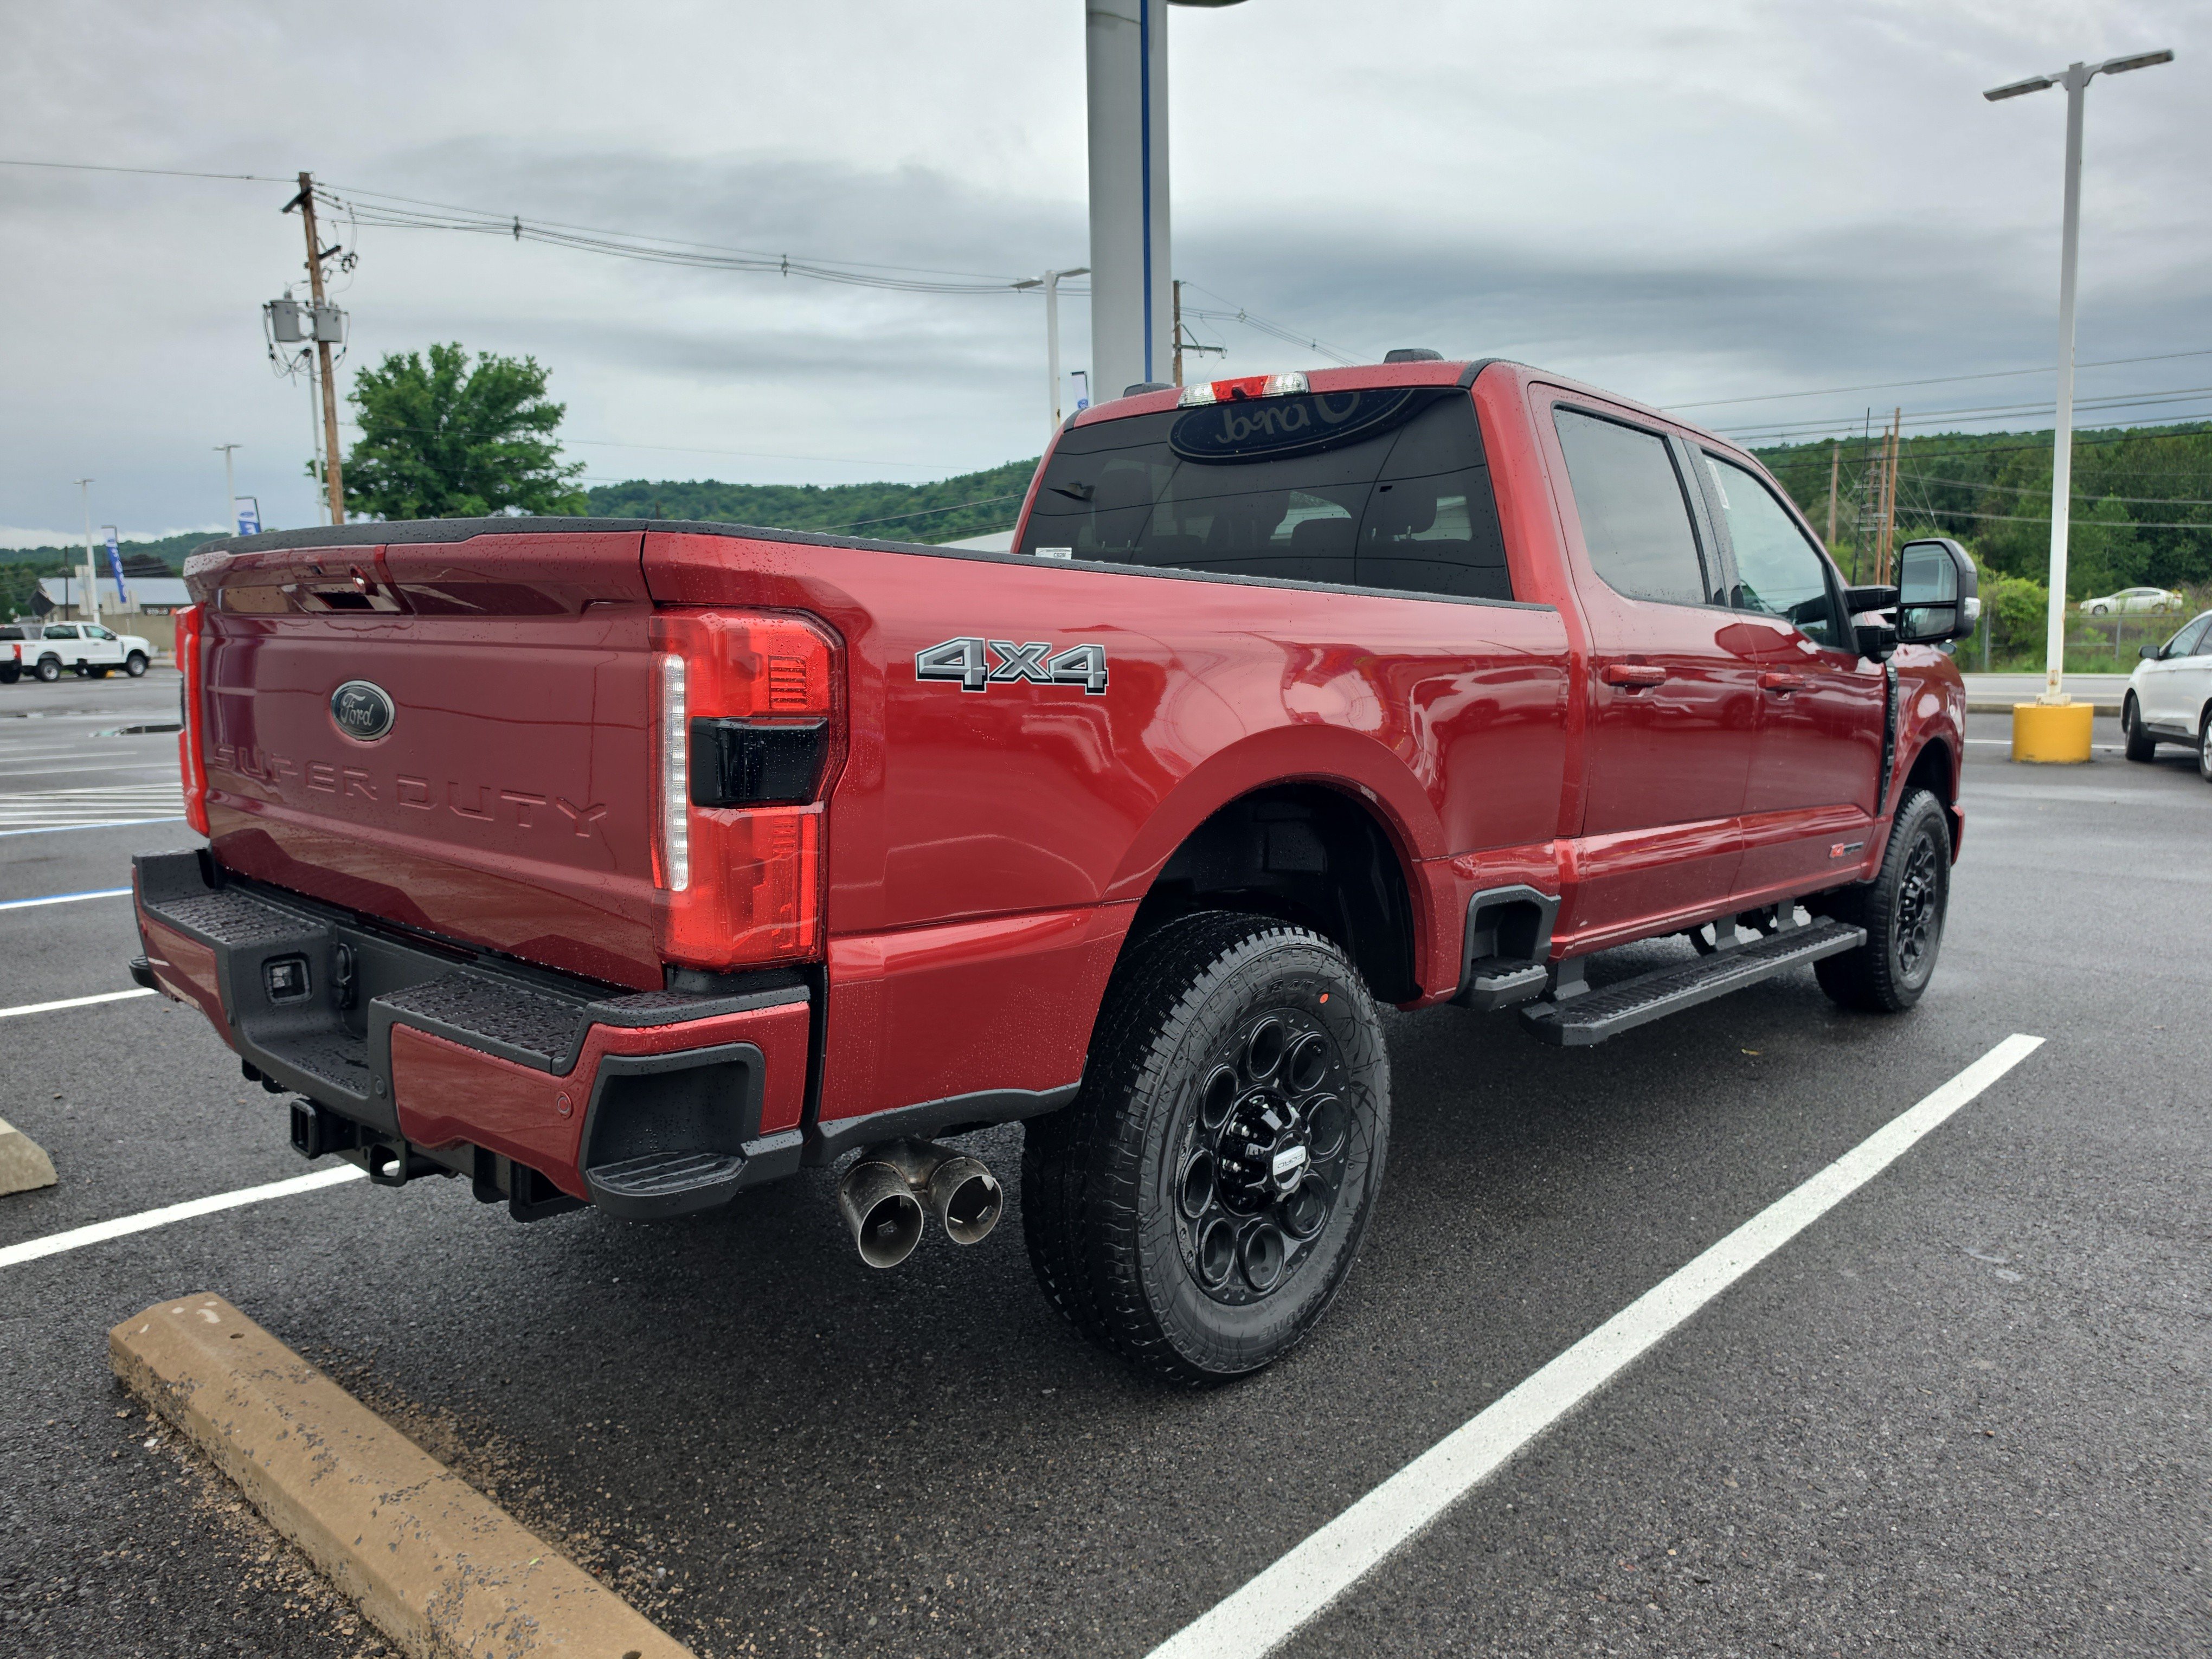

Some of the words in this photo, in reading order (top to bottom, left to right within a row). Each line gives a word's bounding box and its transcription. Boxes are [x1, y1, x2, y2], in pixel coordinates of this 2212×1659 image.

[339, 692, 374, 726] Ford
[213, 742, 378, 801] SUPER
[396, 773, 607, 838] DUTY
[1277, 1153, 1303, 1169] FORD
